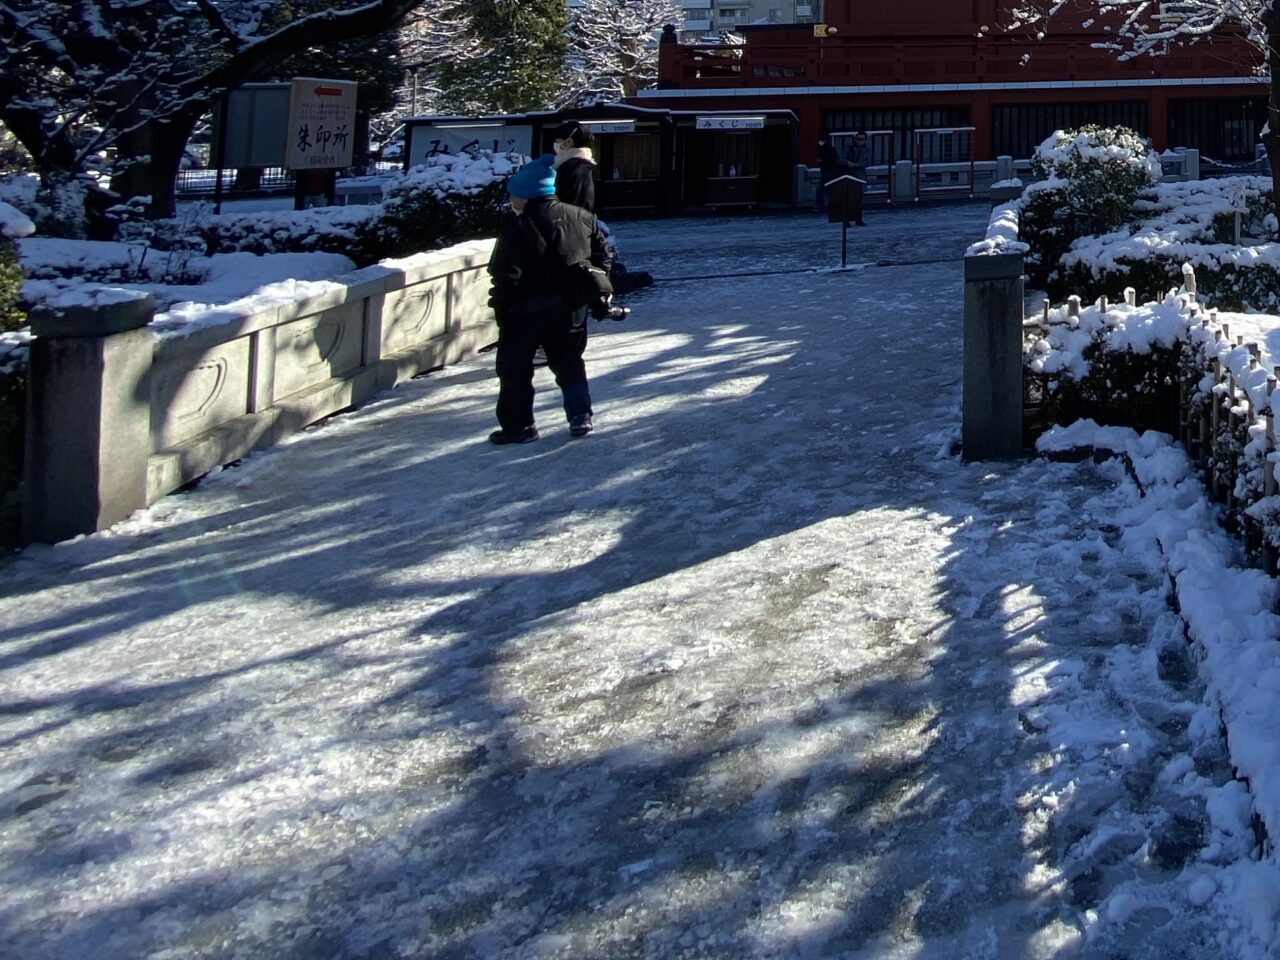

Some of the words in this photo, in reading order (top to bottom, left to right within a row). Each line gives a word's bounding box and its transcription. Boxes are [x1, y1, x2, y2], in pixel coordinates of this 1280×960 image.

[703, 120, 739, 128] みくじ
[297, 123, 350, 153] 朱印所
